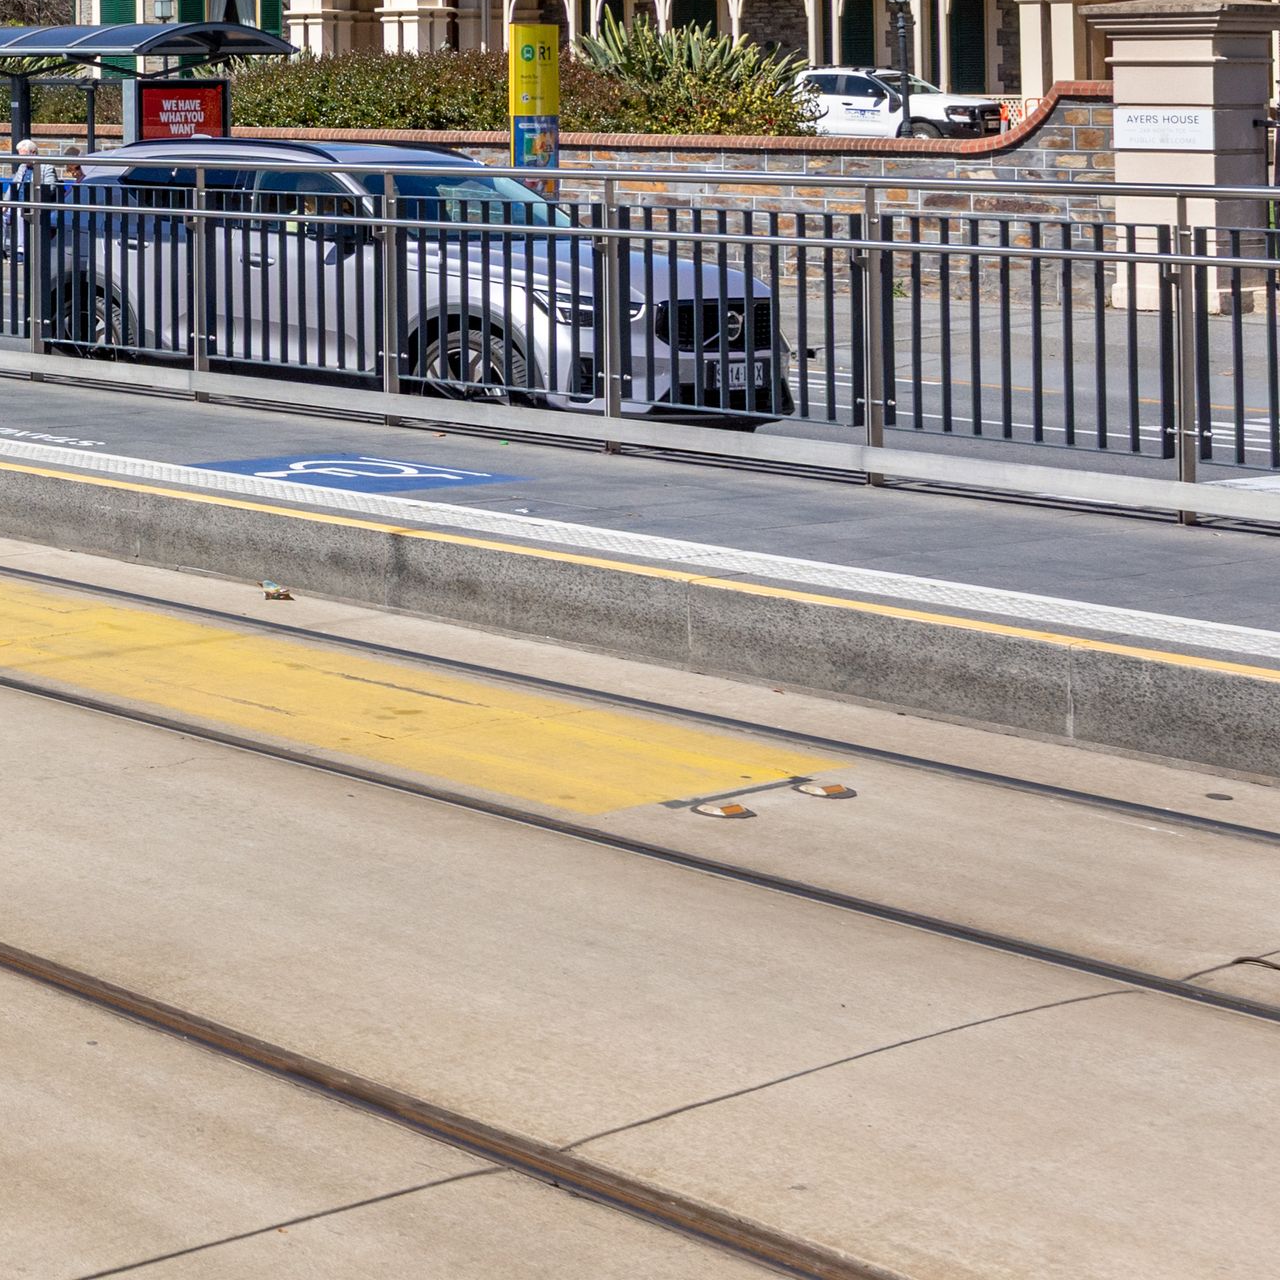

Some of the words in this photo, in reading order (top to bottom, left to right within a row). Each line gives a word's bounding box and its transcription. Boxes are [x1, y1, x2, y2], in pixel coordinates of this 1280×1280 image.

[538, 46, 551, 60] R1
[162, 100, 177, 110] WE
[179, 100, 201, 110] HAVE
[159, 112, 186, 122] WHAT
[186, 112, 204, 122] YOU
[1127, 115, 1158, 124] AYERS
[1163, 115, 1199, 124] HOUSE
[170, 123, 196, 134] WANT
